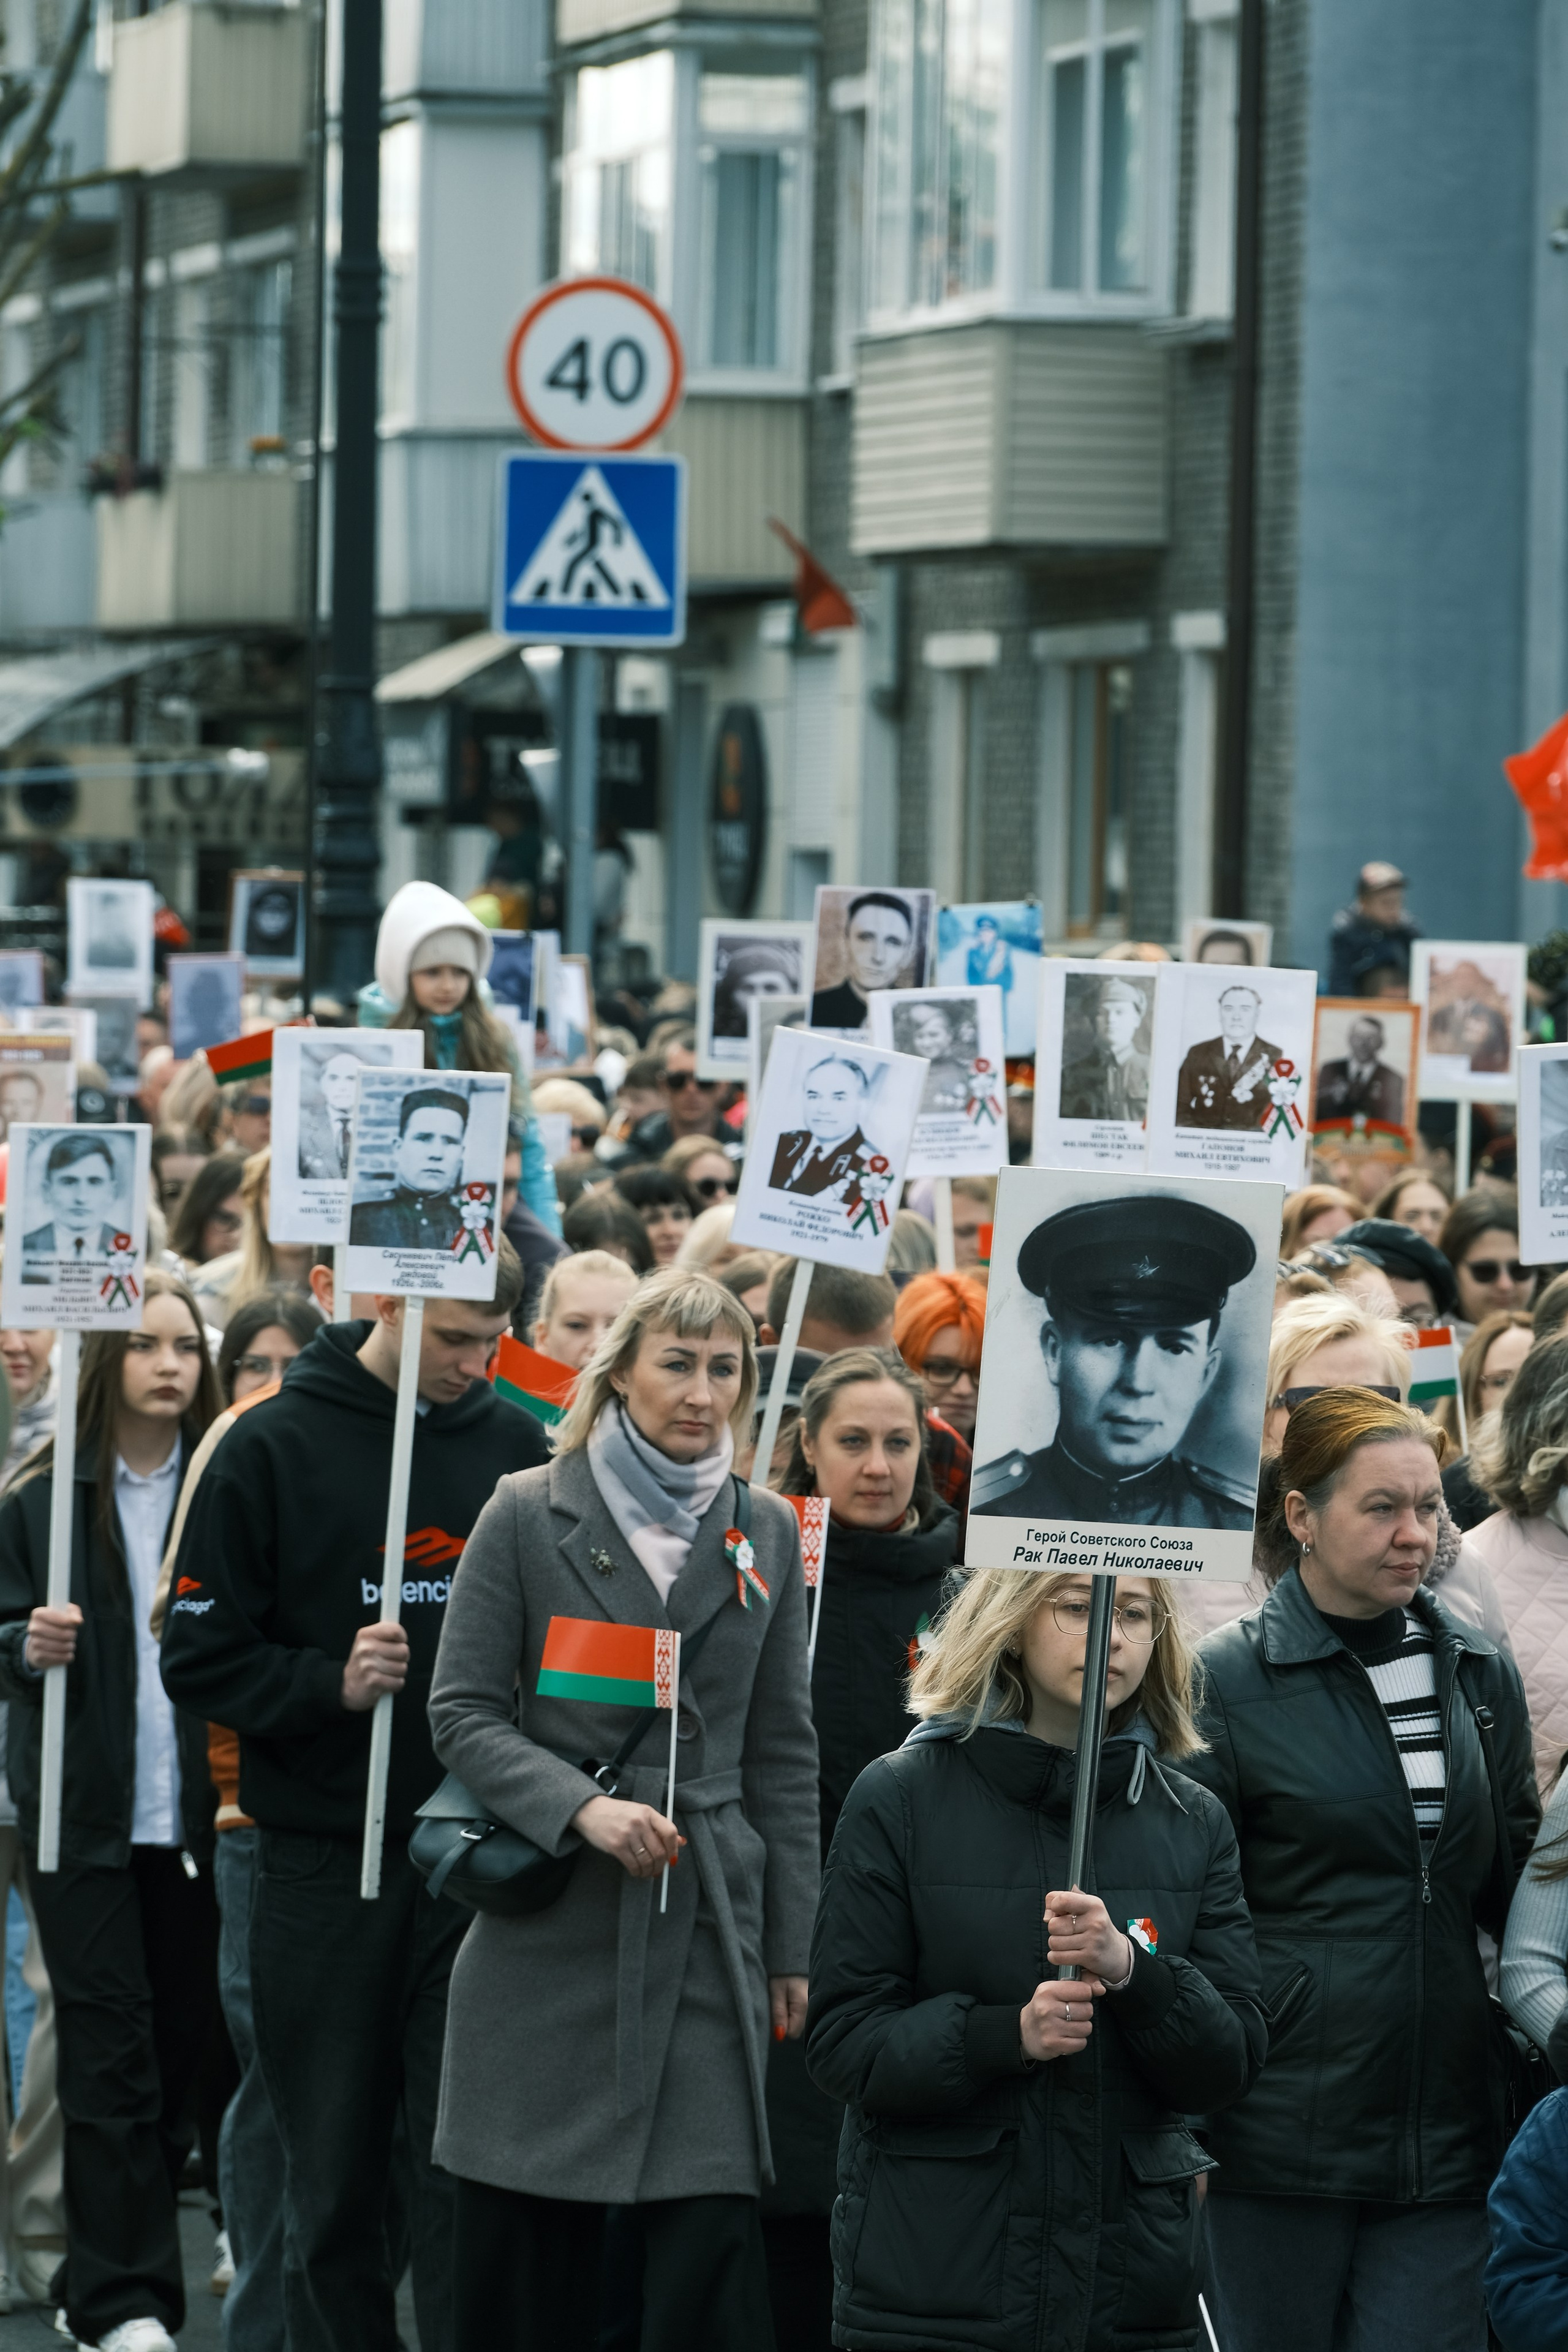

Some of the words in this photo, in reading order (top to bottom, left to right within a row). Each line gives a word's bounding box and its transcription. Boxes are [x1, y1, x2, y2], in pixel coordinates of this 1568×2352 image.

[544, 335, 647, 405] 40
[1027, 1529, 1066, 1545] Герой
[1071, 1531, 1146, 1548] Советского
[1150, 1536, 1193, 1551] Союза
[1013, 1546, 1043, 1563] Рак
[1047, 1548, 1098, 1566] Павел
[1102, 1551, 1204, 1572] Николаевич
